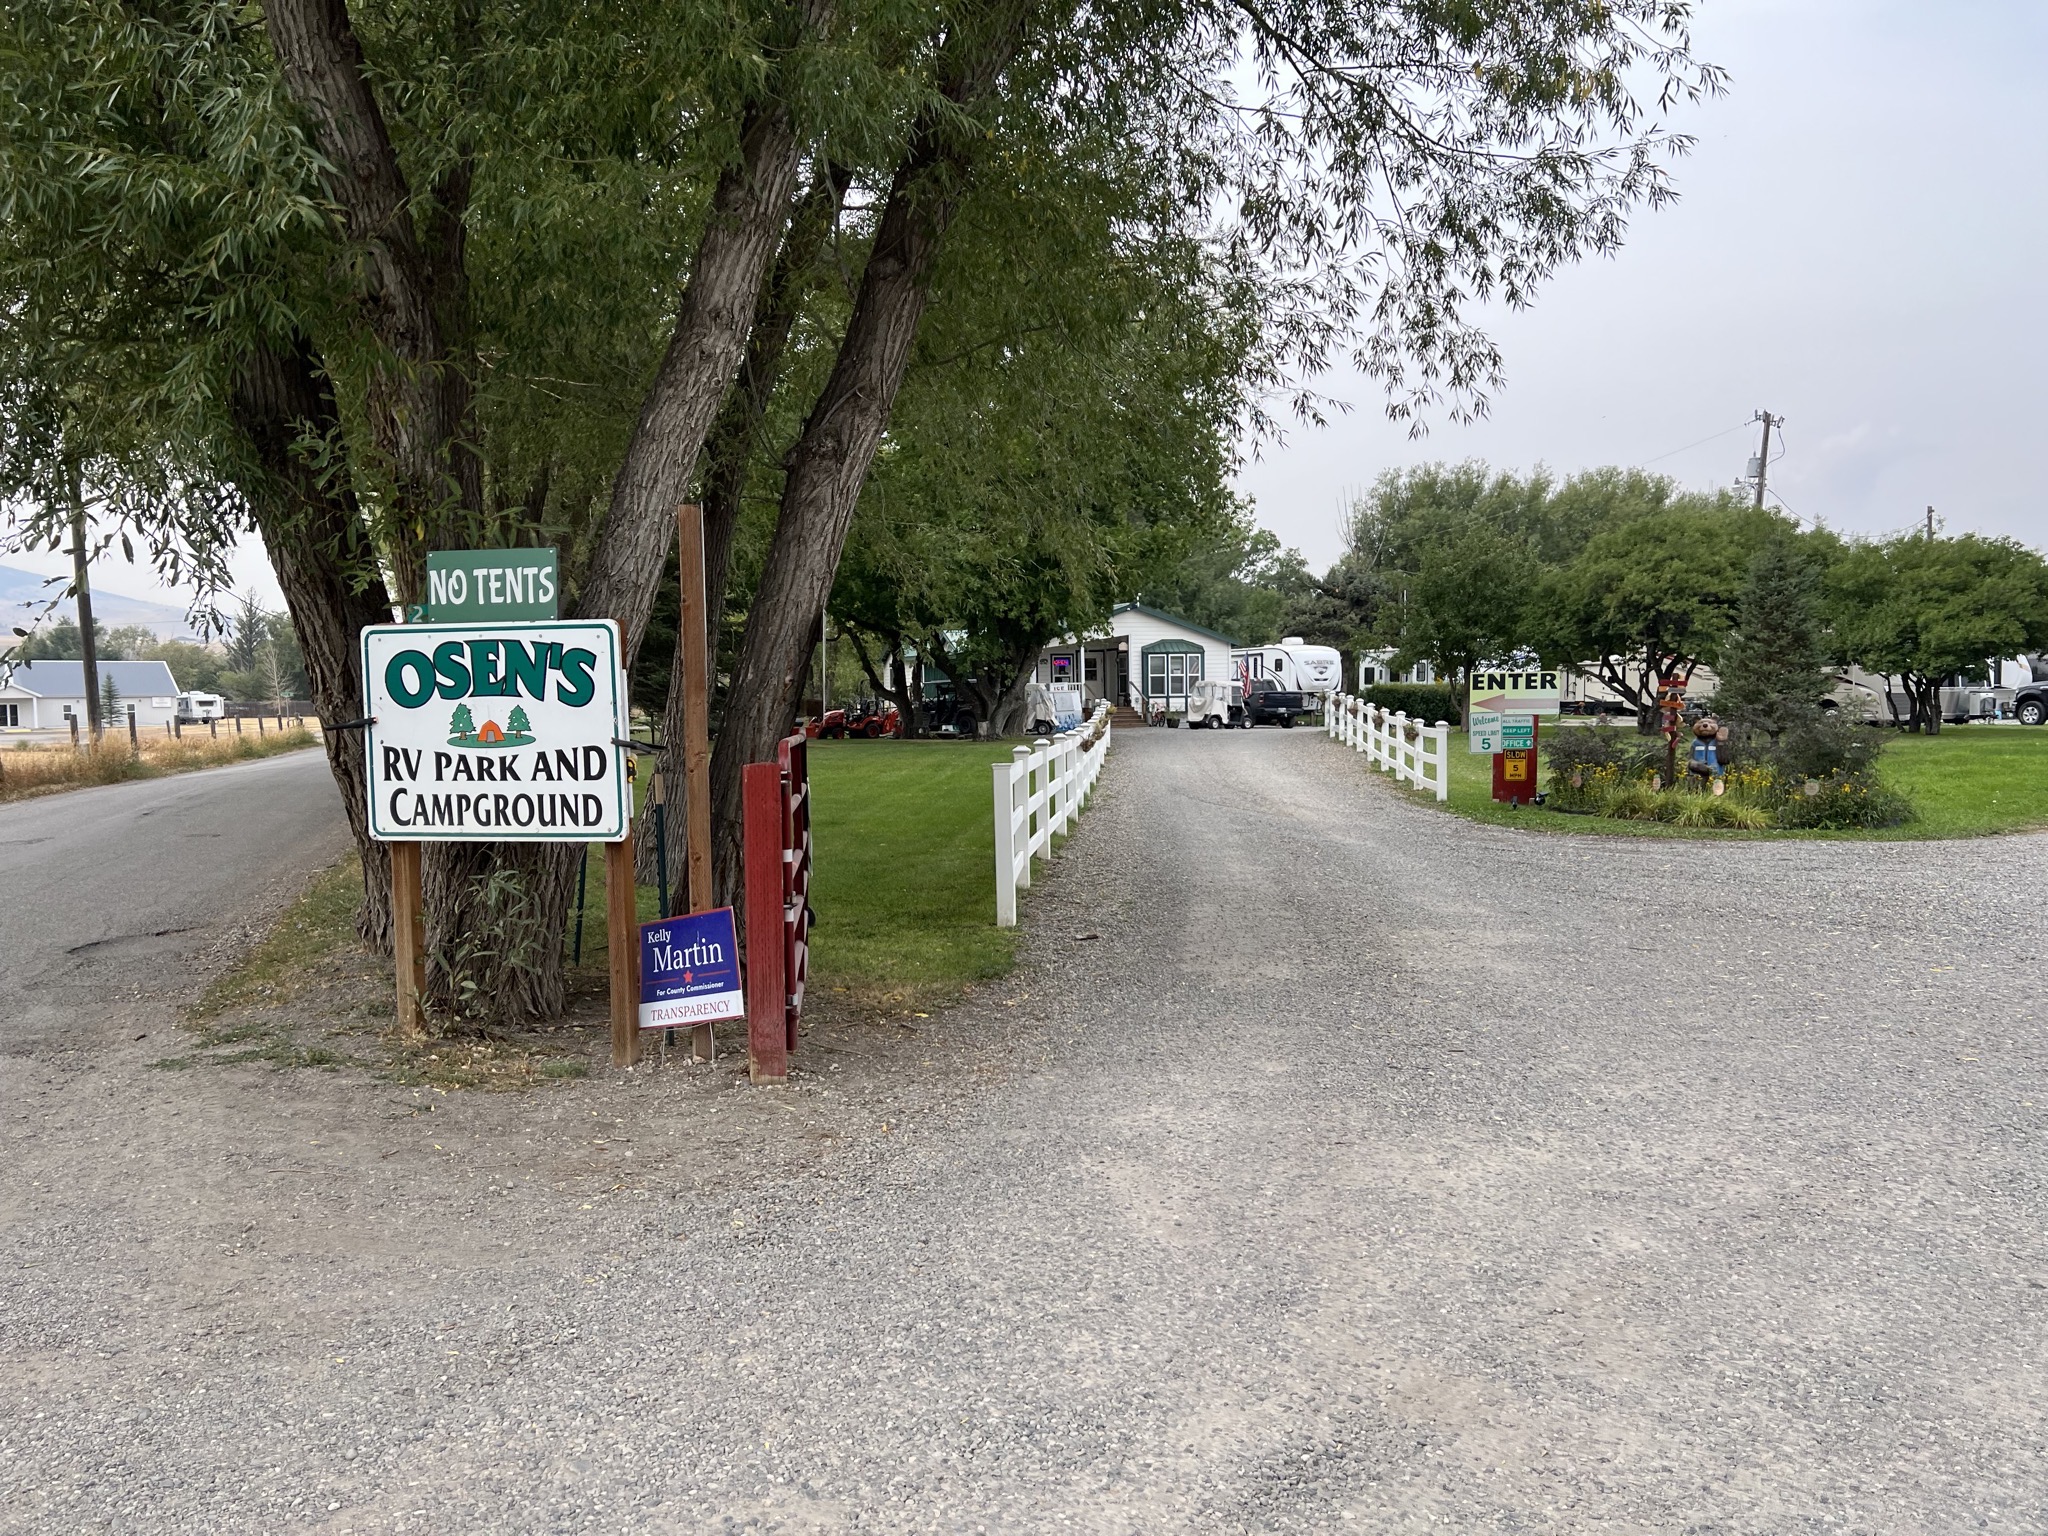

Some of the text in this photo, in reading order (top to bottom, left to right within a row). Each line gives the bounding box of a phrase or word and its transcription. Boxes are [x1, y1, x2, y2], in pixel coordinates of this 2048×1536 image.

[429, 566, 555, 605] NO TENTS
[385, 639, 597, 709] OSEN'S
[1472, 673, 1557, 690] ENTER
[1472, 716, 1499, 726] Welcome
[1481, 738, 1491, 750] 5
[382, 745, 607, 782] RV PARK AND
[1506, 751, 1526, 759] SLOW
[1513, 764, 1519, 772] 5
[389, 788, 603, 827] CAMPGROUND
[647, 929, 671, 943] Kelly
[653, 937, 723, 973] Martin
[666, 986, 686, 995] County
[686, 980, 725, 992] Commissioner
[651, 1000, 730, 1021] TRANSPARENCY
